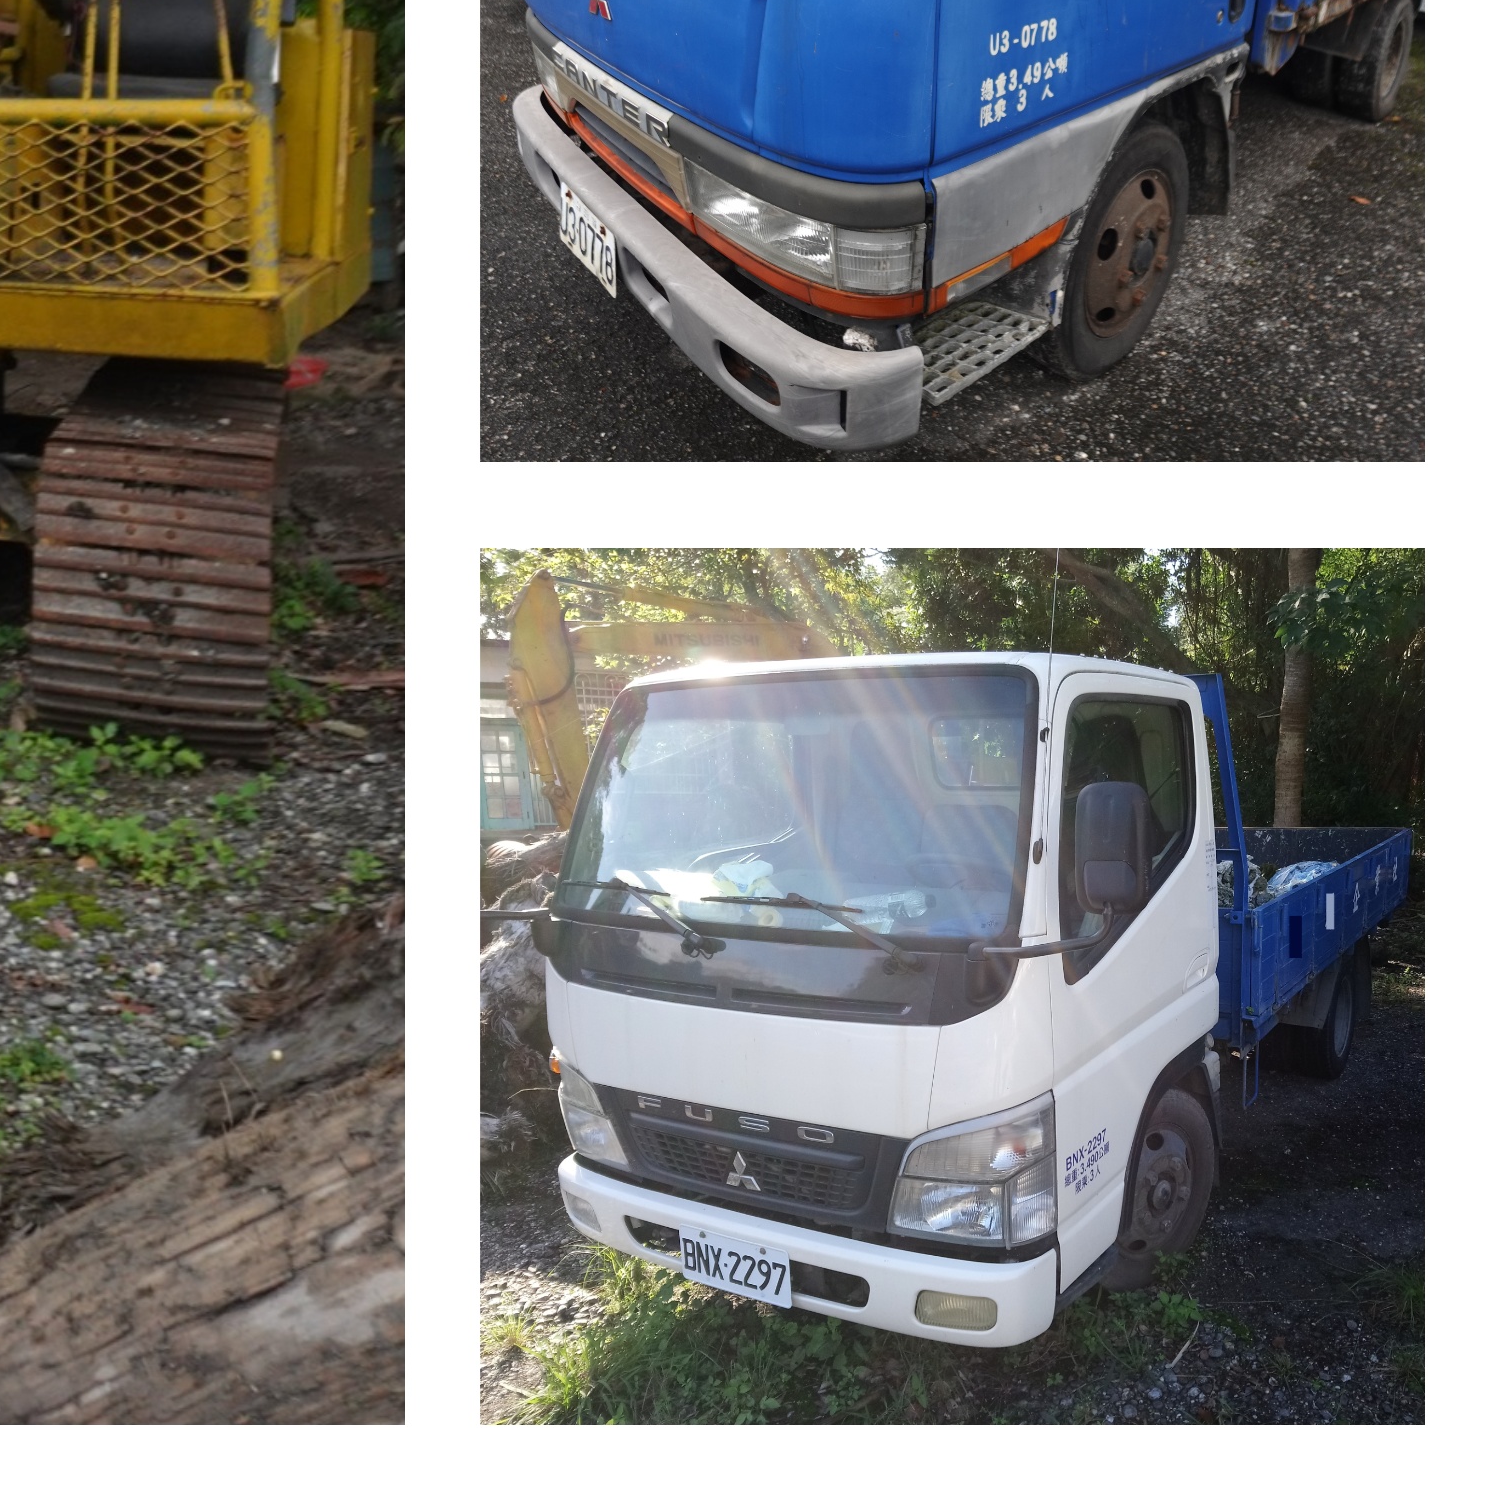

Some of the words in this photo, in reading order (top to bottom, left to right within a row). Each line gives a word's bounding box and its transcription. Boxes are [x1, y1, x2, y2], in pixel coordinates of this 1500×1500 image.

[989, 17, 1058, 56] U3-0778
[552, 47, 671, 148] CANTER
[653, 632, 761, 647] MITSUBISHI
[637, 1095, 835, 1144] FUSO
[1065, 1127, 1107, 1172] BNX-2297
